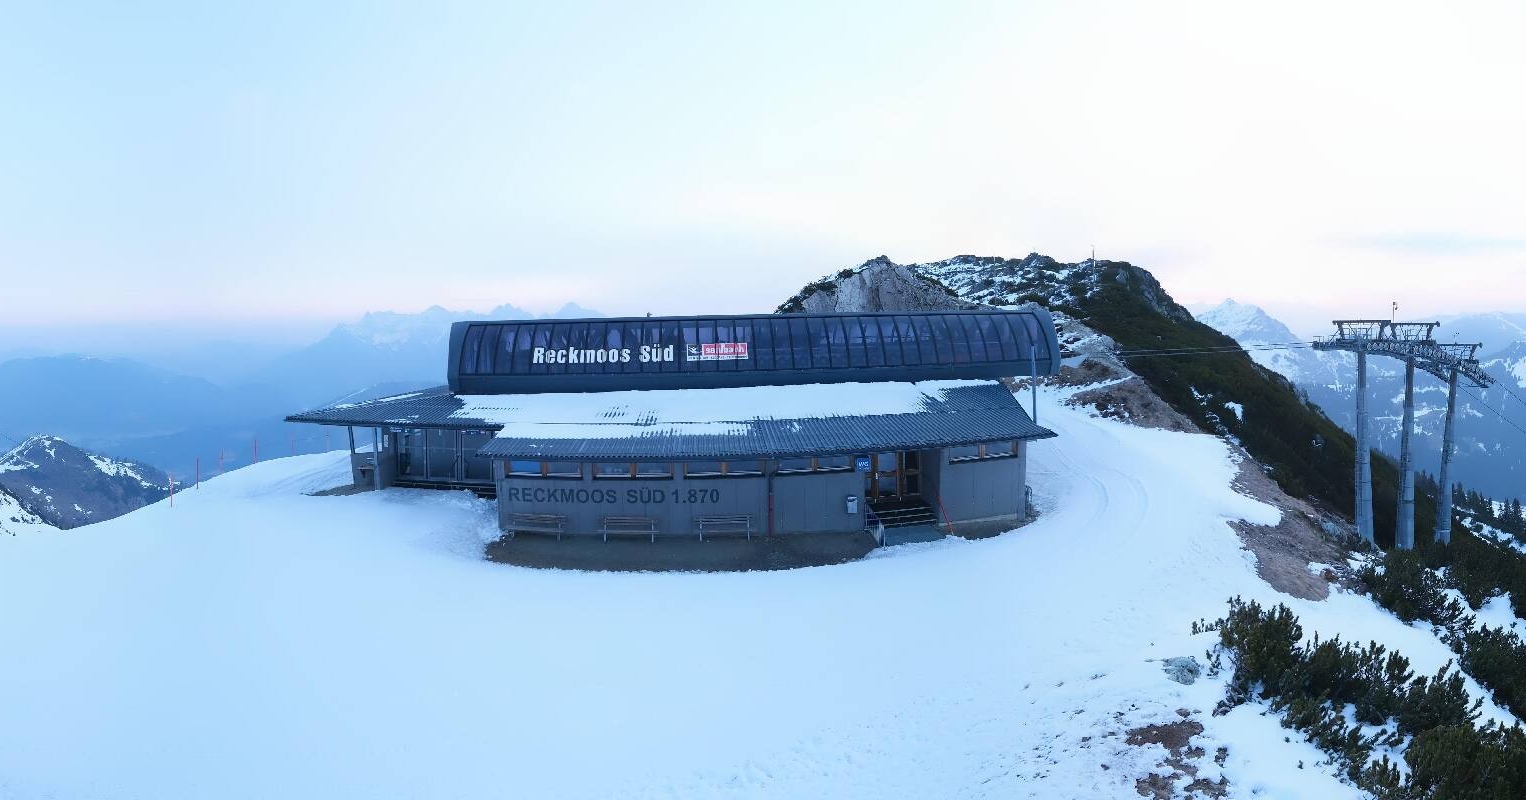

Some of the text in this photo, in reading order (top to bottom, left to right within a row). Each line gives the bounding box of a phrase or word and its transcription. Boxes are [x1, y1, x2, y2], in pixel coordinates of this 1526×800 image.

[532, 343, 674, 364] Reckmoos Süd
[508, 487, 720, 504] RECKMOOS SÜD 1.870
